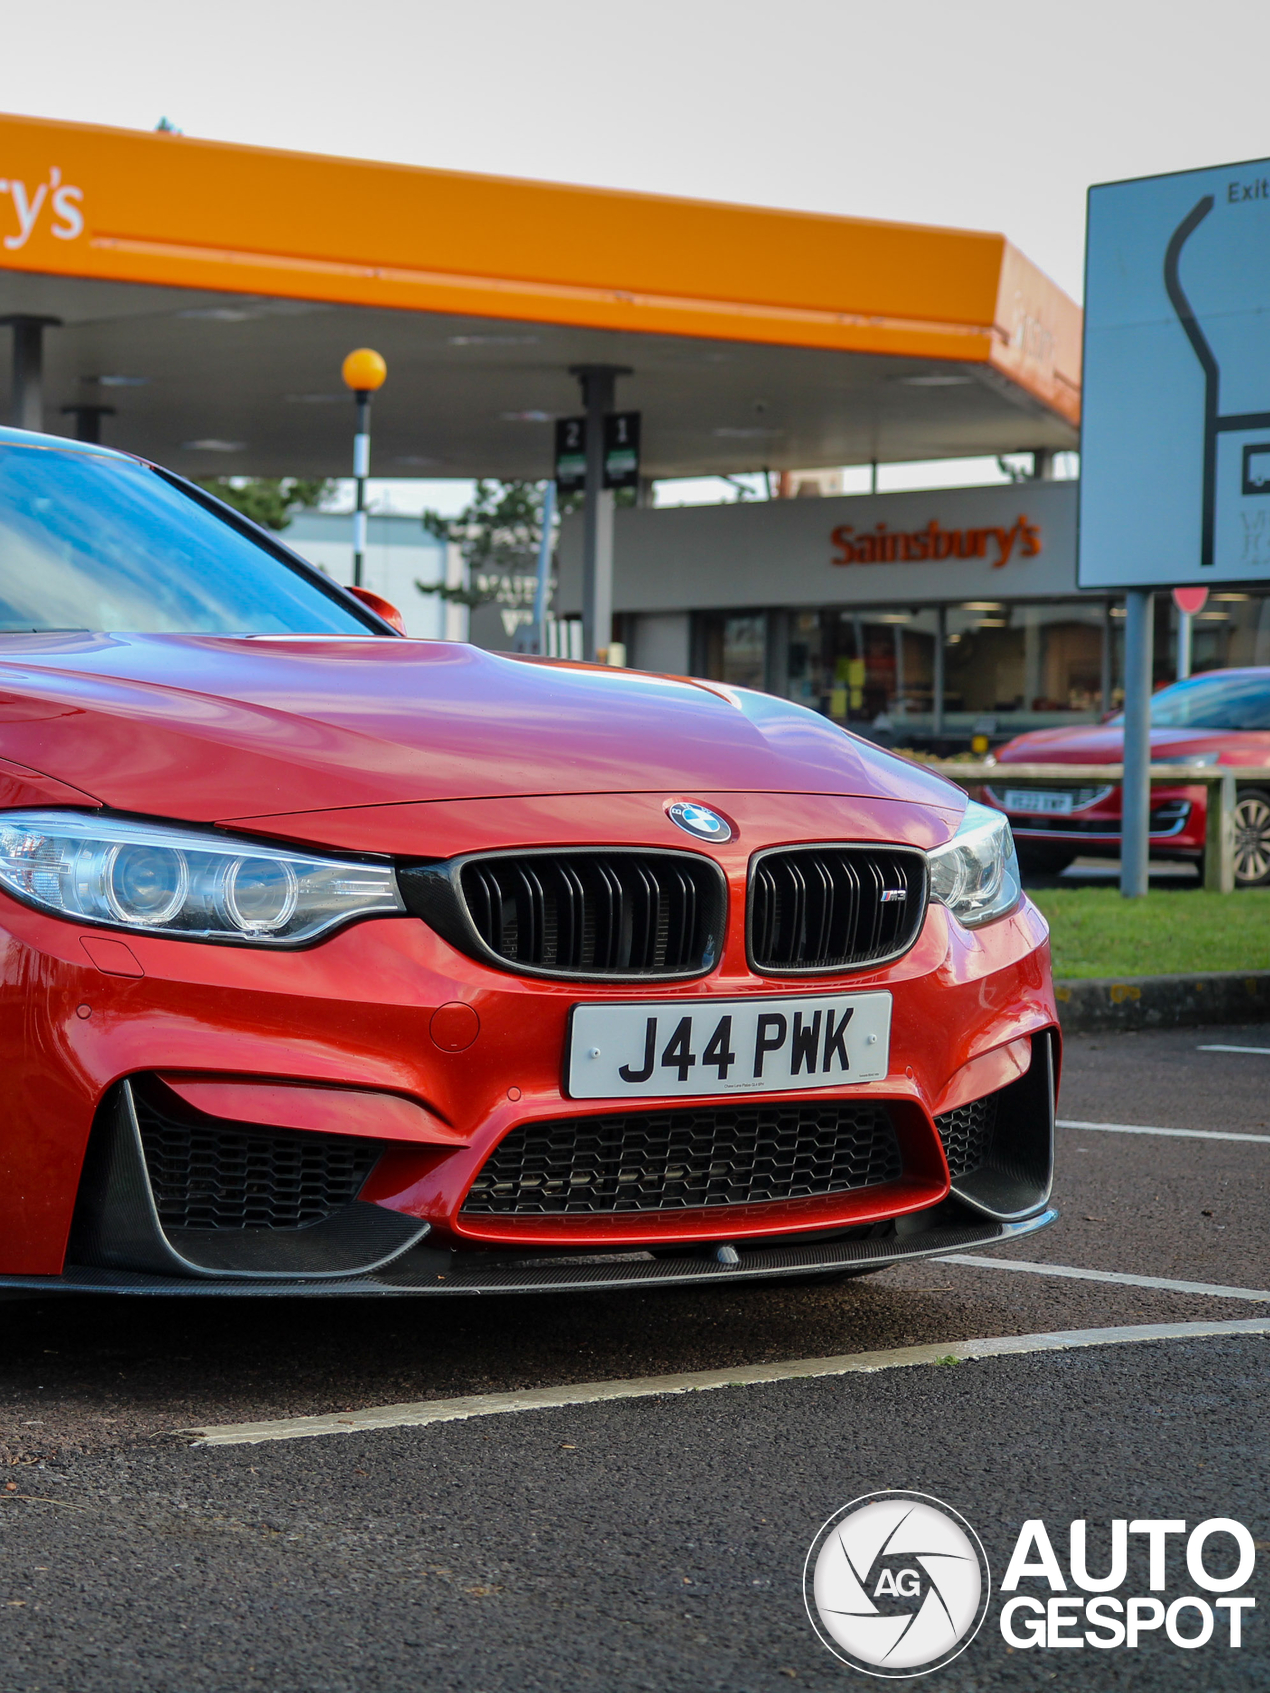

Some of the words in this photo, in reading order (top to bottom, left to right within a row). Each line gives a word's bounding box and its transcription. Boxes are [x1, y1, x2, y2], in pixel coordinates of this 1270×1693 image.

[1227, 177, 1270, 204] Exit
[831, 513, 1042, 568] Sainsbury's
[618, 1015, 736, 1083] J44
[753, 1007, 855, 1079] PWK
